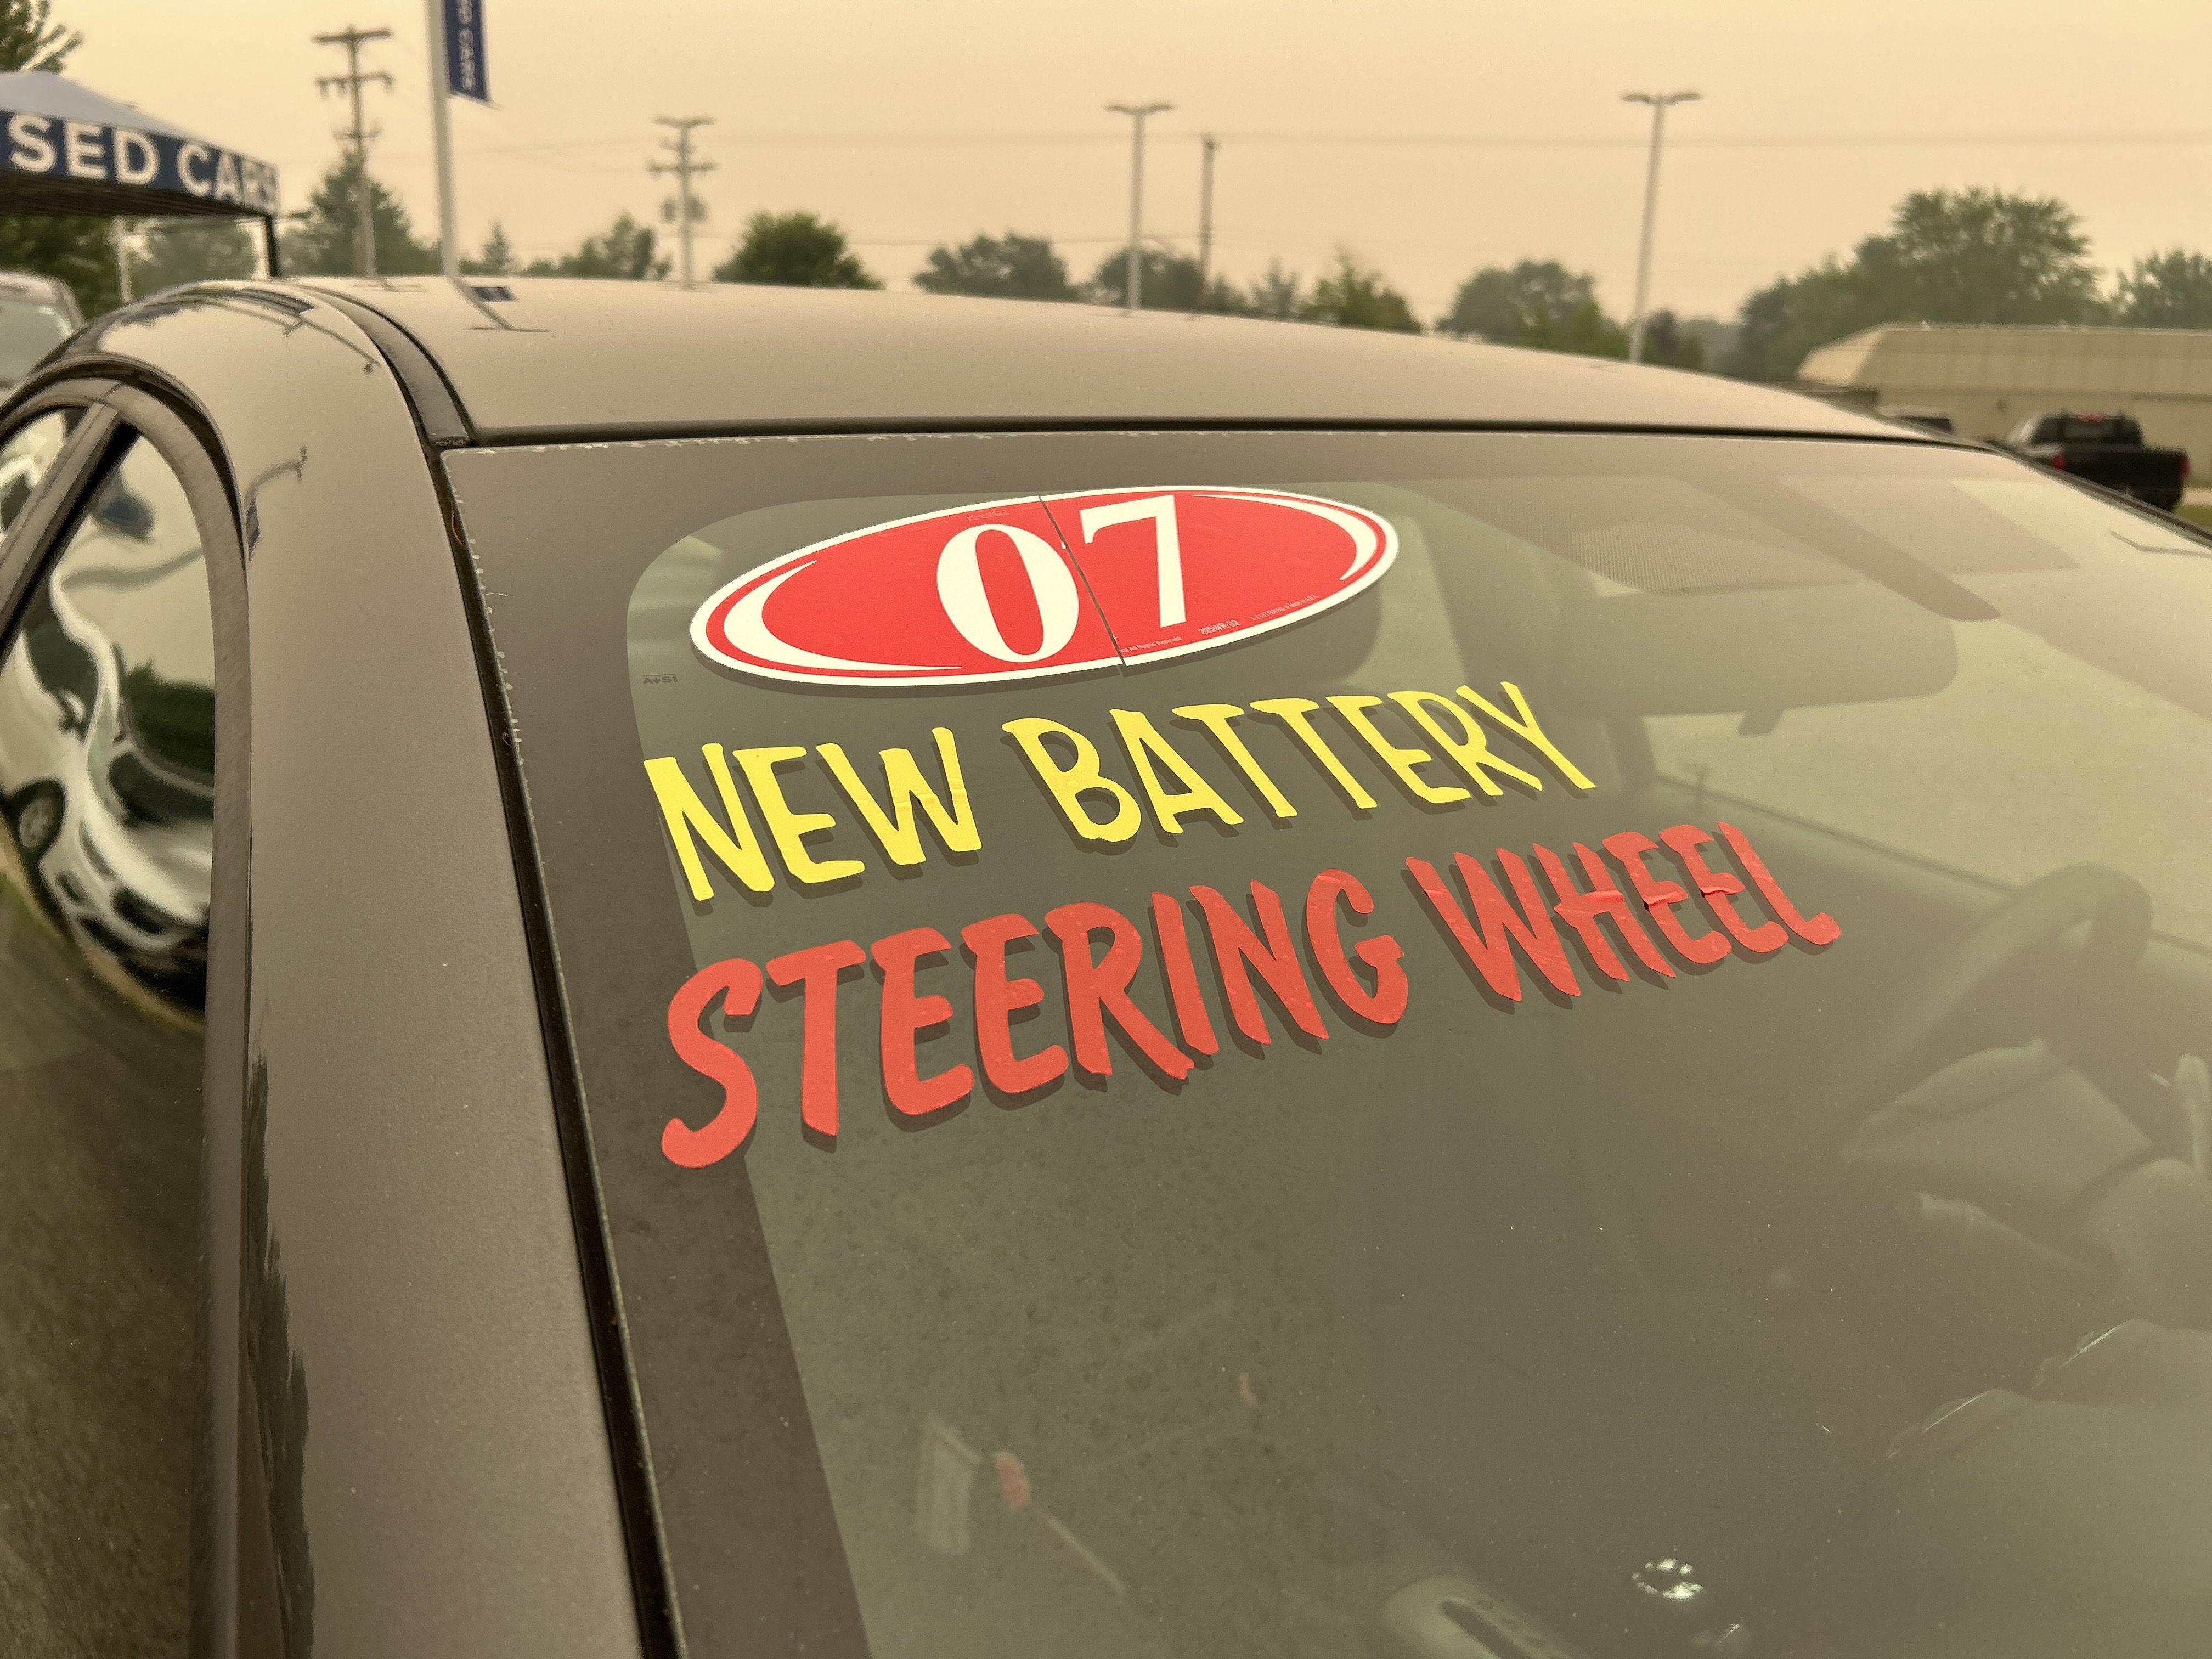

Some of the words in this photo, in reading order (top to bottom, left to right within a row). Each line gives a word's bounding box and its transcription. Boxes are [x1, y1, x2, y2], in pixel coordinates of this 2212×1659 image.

[176, 143, 279, 212] CARS
[936, 494, 1186, 663] 07
[644, 727, 982, 900] NEW
[1002, 682, 1594, 842] BATTERY
[661, 868, 1409, 1169] STEERING
[1406, 821, 1841, 1002] WHEEL
